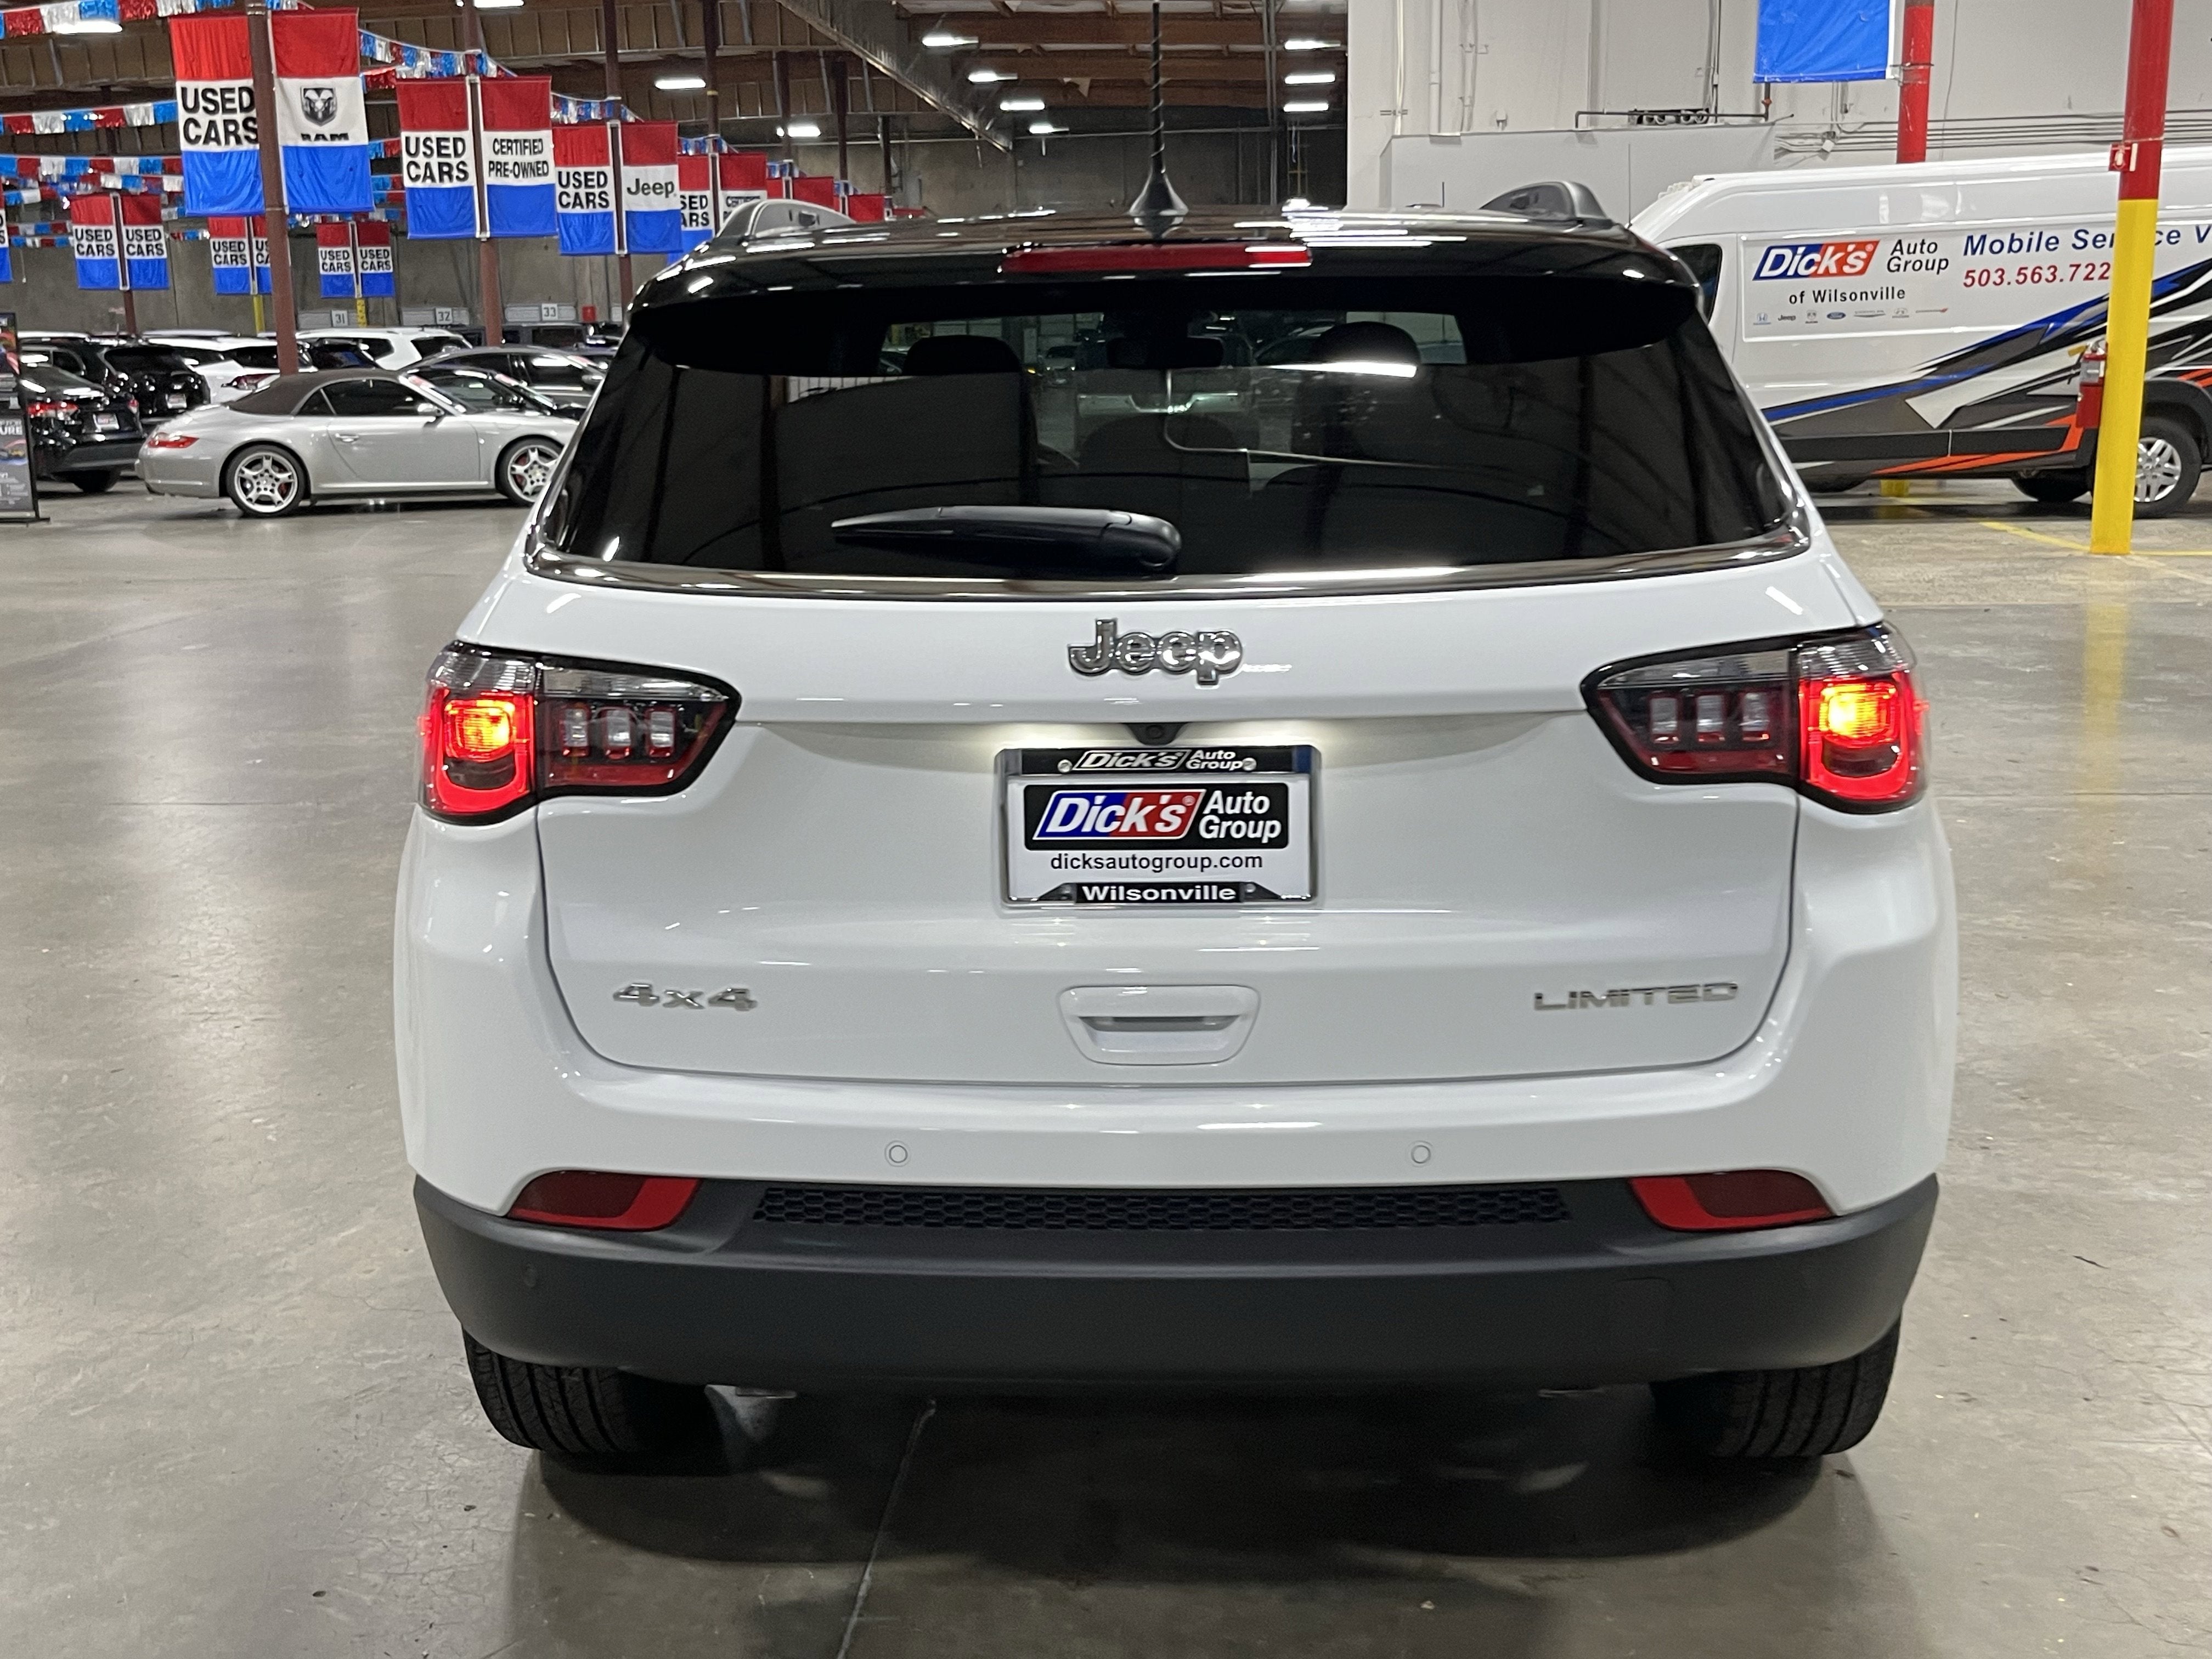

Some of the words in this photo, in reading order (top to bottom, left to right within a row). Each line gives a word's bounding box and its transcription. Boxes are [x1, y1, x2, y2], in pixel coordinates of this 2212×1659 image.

[180, 87, 256, 115] USED
[183, 117, 258, 145] CARS
[301, 133, 349, 142] RAM
[405, 136, 466, 159] USED
[493, 138, 544, 156] CERTIFIED
[407, 160, 469, 183] CARS
[488, 160, 549, 179] PRE-OWNED
[558, 171, 608, 189] USED
[627, 178, 675, 199] Jeep
[558, 191, 610, 210] CARS
[680, 195, 708, 210] SED
[75, 228, 112, 242] USED
[126, 228, 161, 242] USED
[1963, 231, 2059, 256] Mobile
[76, 243, 115, 256] CARS
[126, 243, 165, 256] CARS
[212, 240, 246, 253] USED
[360, 249, 390, 259] USED
[1890, 239, 1938, 256] Auto
[213, 253, 247, 266] CARS
[320, 250, 350, 261] USED
[1759, 244, 1867, 278] Dick's
[321, 261, 352, 273] CARS
[361, 260, 391, 271] CARS
[1886, 255, 1950, 275] Group
[1963, 261, 2112, 288] 503.563.722
[1788, 291, 1805, 304] of
[1813, 286, 1906, 302] Wilsonville
[336, 313, 345, 324] 31
[438, 311, 450, 322] 32
[543, 307, 556, 318] 33
[1068, 618, 1243, 686] Jeep
[1081, 751, 1181, 768] Dick's
[1191, 750, 1236, 760] Auto
[1186, 760, 1243, 771] Group
[1203, 790, 1271, 815] Auto
[1045, 794, 1187, 833] Dick's
[1199, 816, 1282, 843] Group
[1051, 853, 1263, 873] dicksautogroup.com
[1081, 884, 1237, 901] Wilsonville
[1534, 981, 1739, 1011] LIMITED
